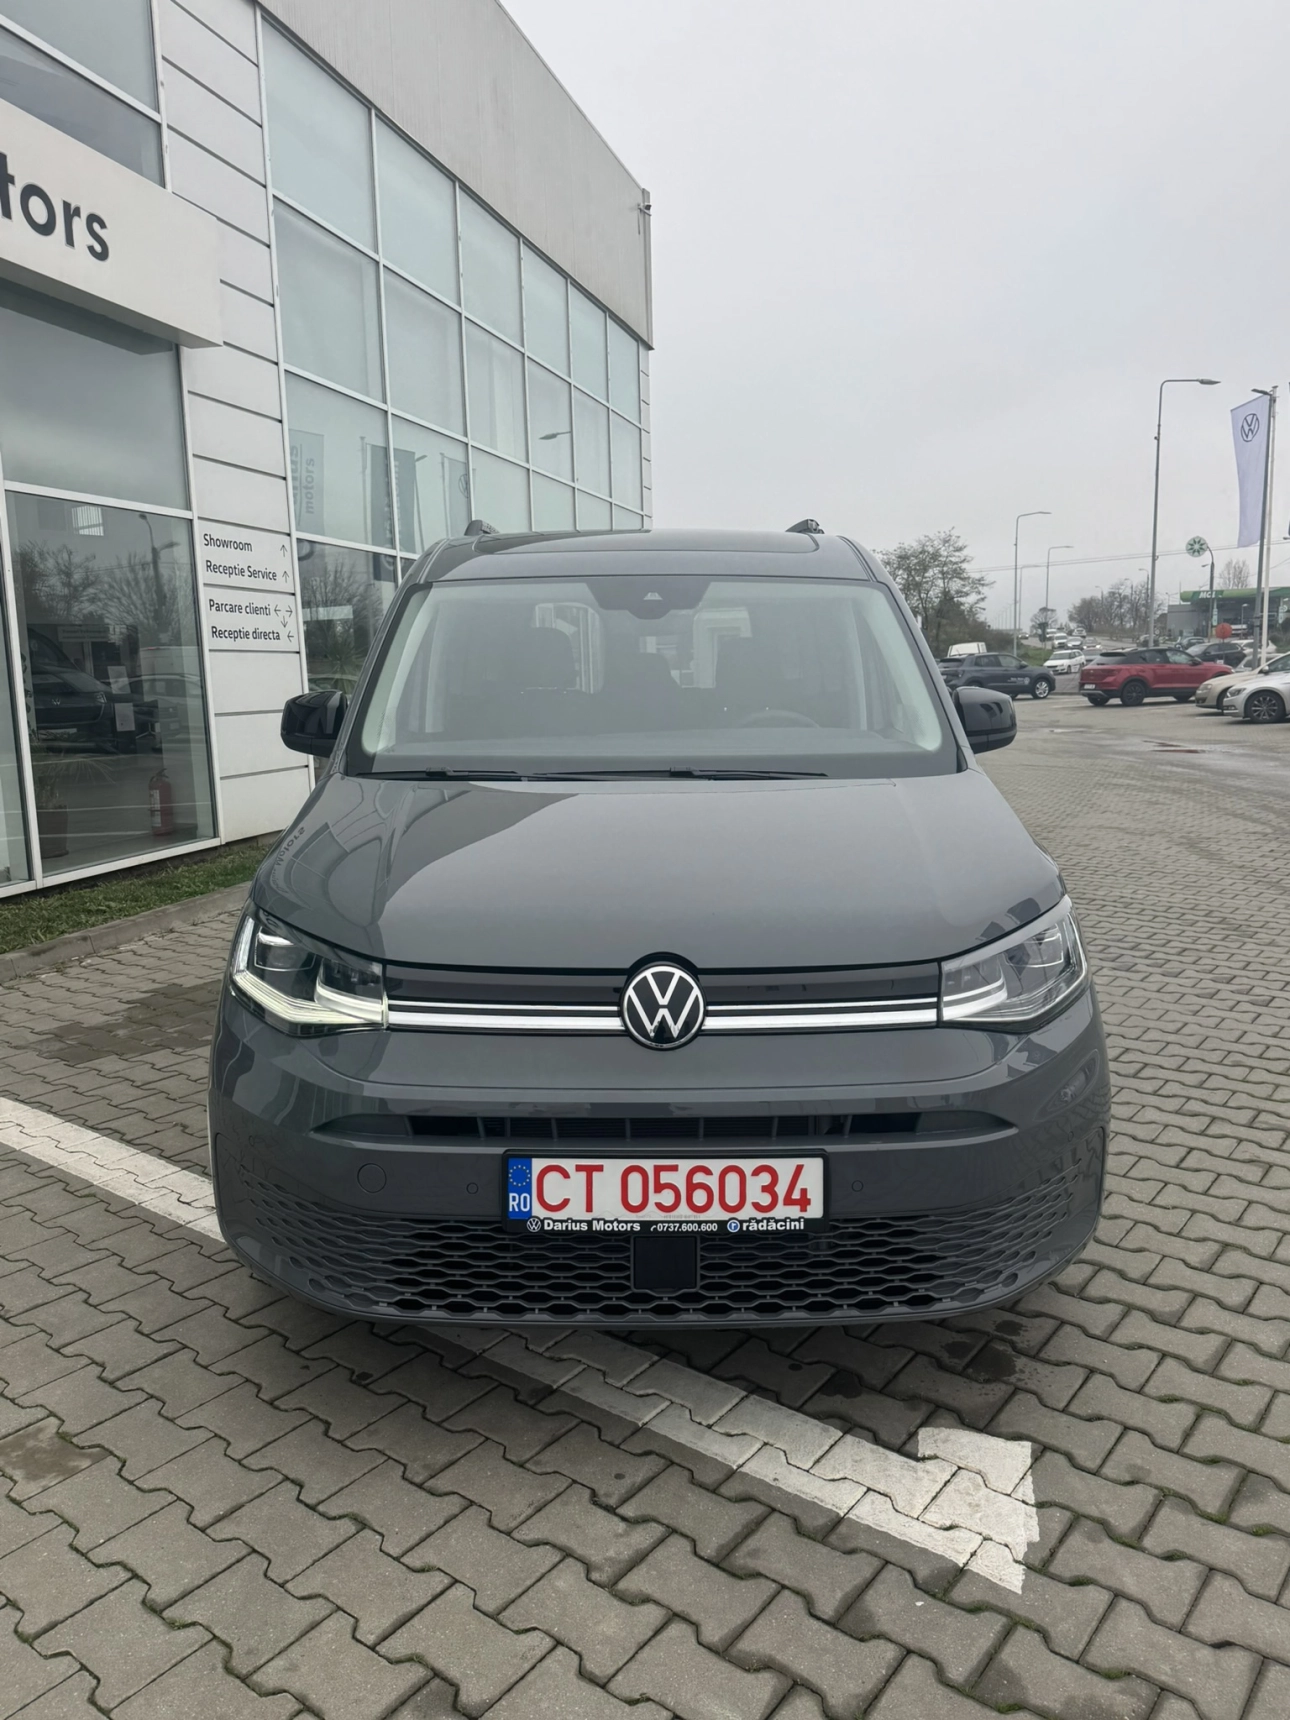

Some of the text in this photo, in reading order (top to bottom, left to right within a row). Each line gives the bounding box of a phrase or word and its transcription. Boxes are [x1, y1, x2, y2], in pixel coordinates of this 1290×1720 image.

[303, 458, 315, 515] motors
[203, 533, 253, 552] Showroom
[205, 559, 277, 581] Receptie Service
[208, 598, 271, 616] Parcare clienti
[211, 625, 281, 642] Receptie directa
[624, 966, 703, 1047] VW
[536, 1164, 811, 1213] CT 056034
[508, 1192, 530, 1212] RO
[544, 1219, 588, 1231] Darius
[592, 1220, 641, 1231] Motors
[657, 1223, 718, 1232] 0737.600.600
[742, 1219, 805, 1231] rădăcini
